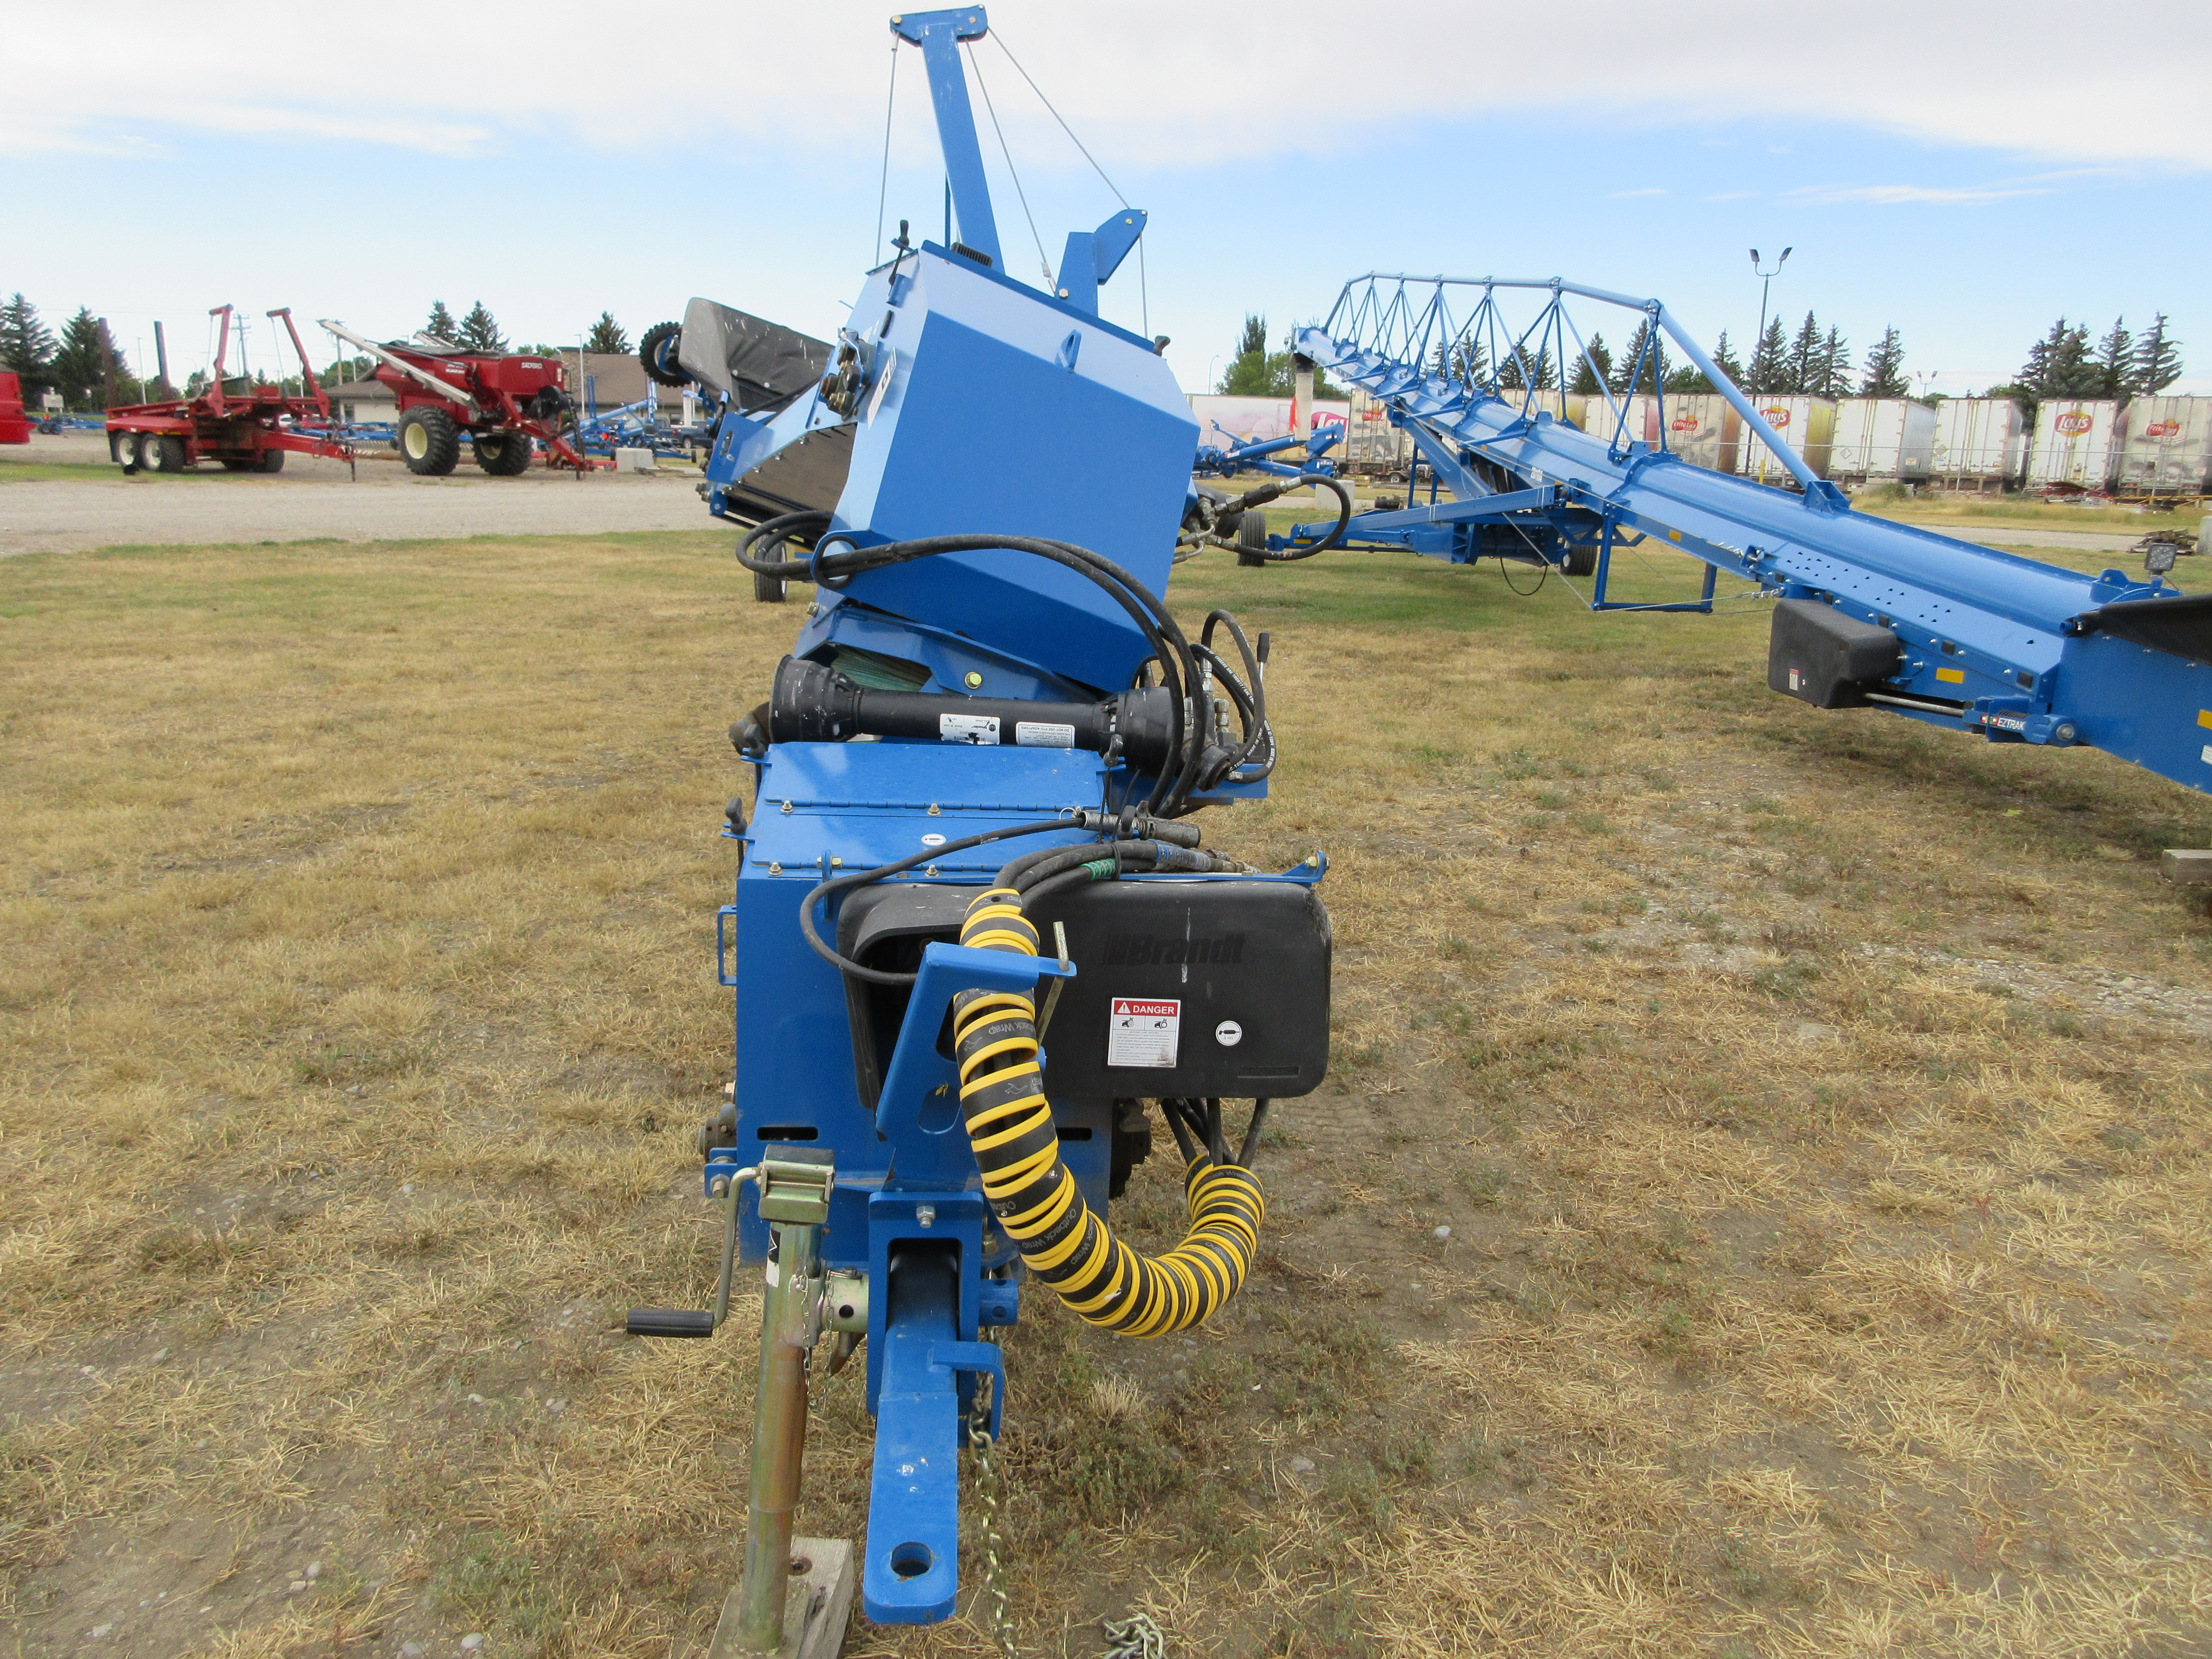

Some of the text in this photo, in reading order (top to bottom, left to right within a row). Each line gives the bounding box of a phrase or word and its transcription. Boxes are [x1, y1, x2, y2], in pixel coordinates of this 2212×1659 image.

[2057, 416, 2089, 432] Lay's
[1997, 717, 2026, 731] EZTRAK
[1133, 1005, 1175, 1015] DANGER
[988, 1022, 1015, 1035] Wrap
[1044, 1208, 1077, 1241] Outback
[1070, 1243, 1091, 1265] Wrap
